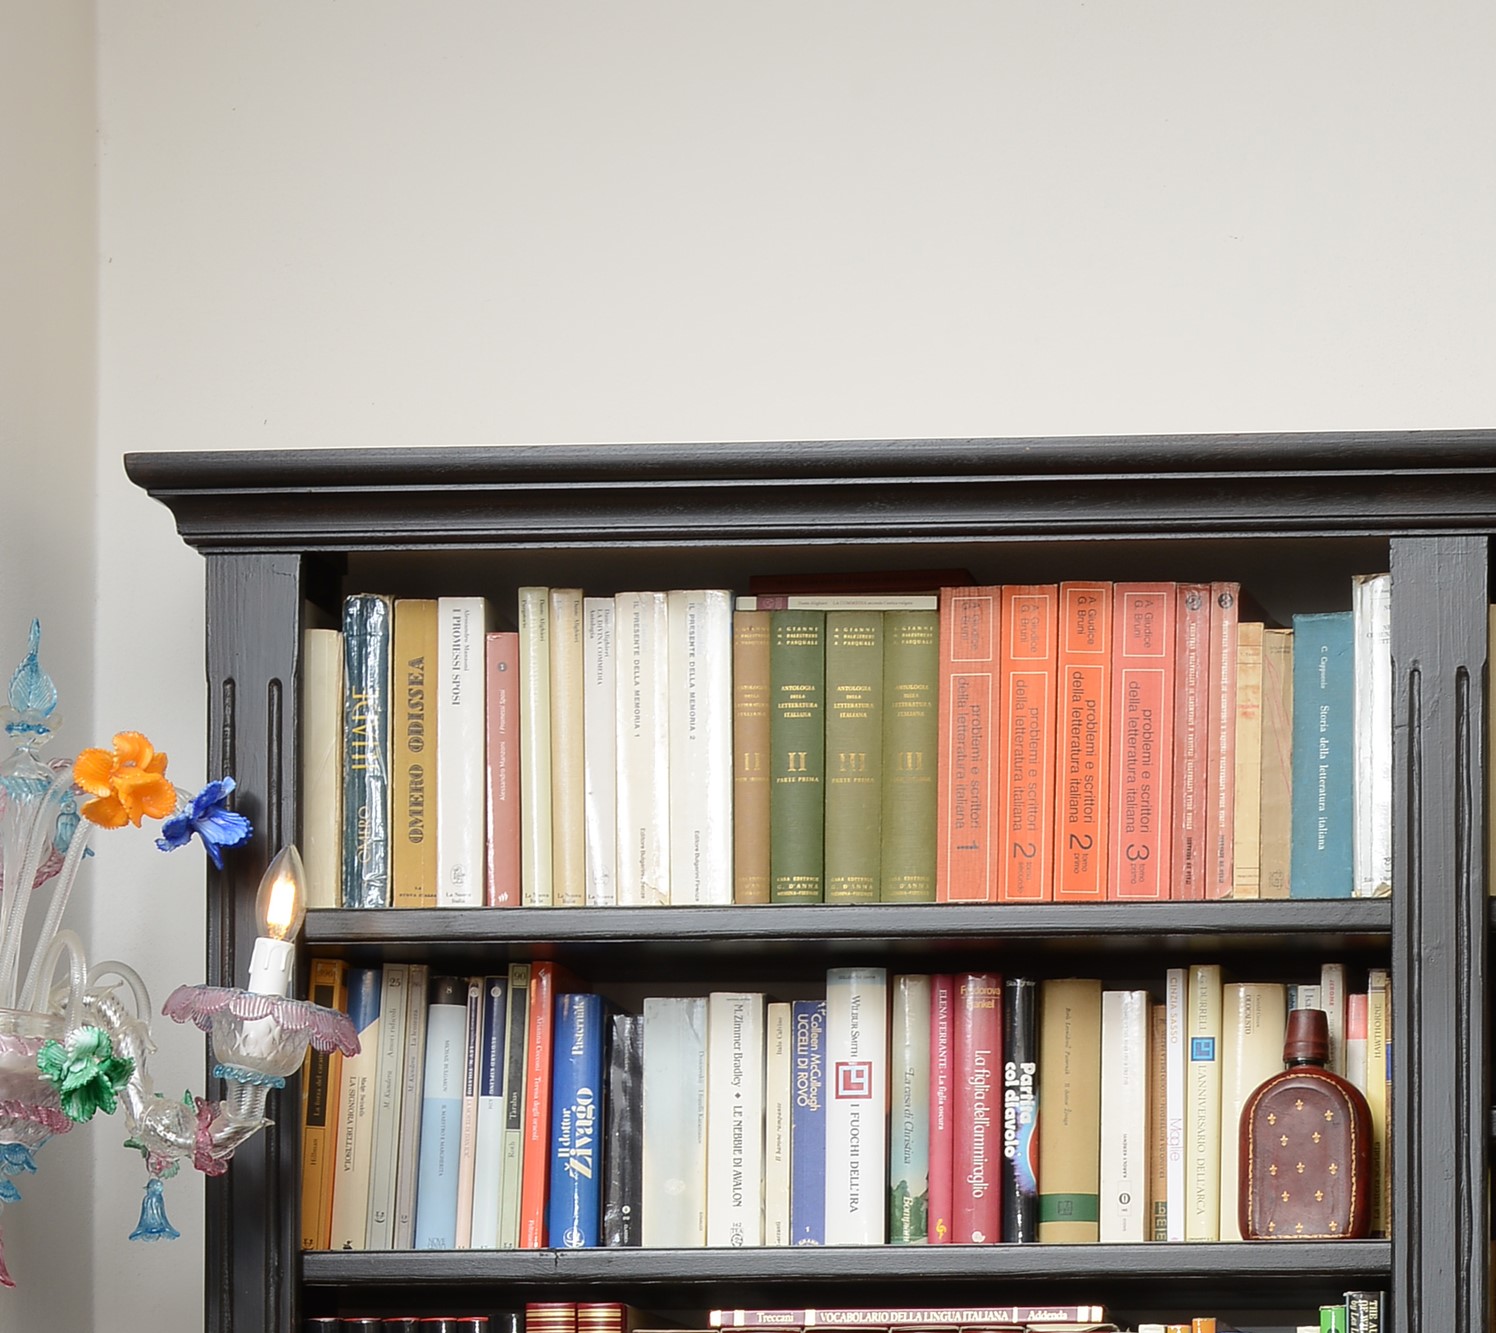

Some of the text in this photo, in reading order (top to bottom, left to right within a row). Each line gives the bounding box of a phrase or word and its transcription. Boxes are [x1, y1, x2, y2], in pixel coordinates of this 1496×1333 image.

[408, 656, 425, 844] OMERO ODISSEA
[797, 1014, 807, 1107] UCCELLI DI ROVO
[1020, 1061, 1036, 1125] Partita
[558, 1108, 570, 1158] Il dottor
[733, 1106, 742, 1207] LE NEBBIE DI AVALON
[967, 1050, 991, 1198] La figlia dell'ammiraglio
[1004, 1062, 1019, 1158] col diavolo
